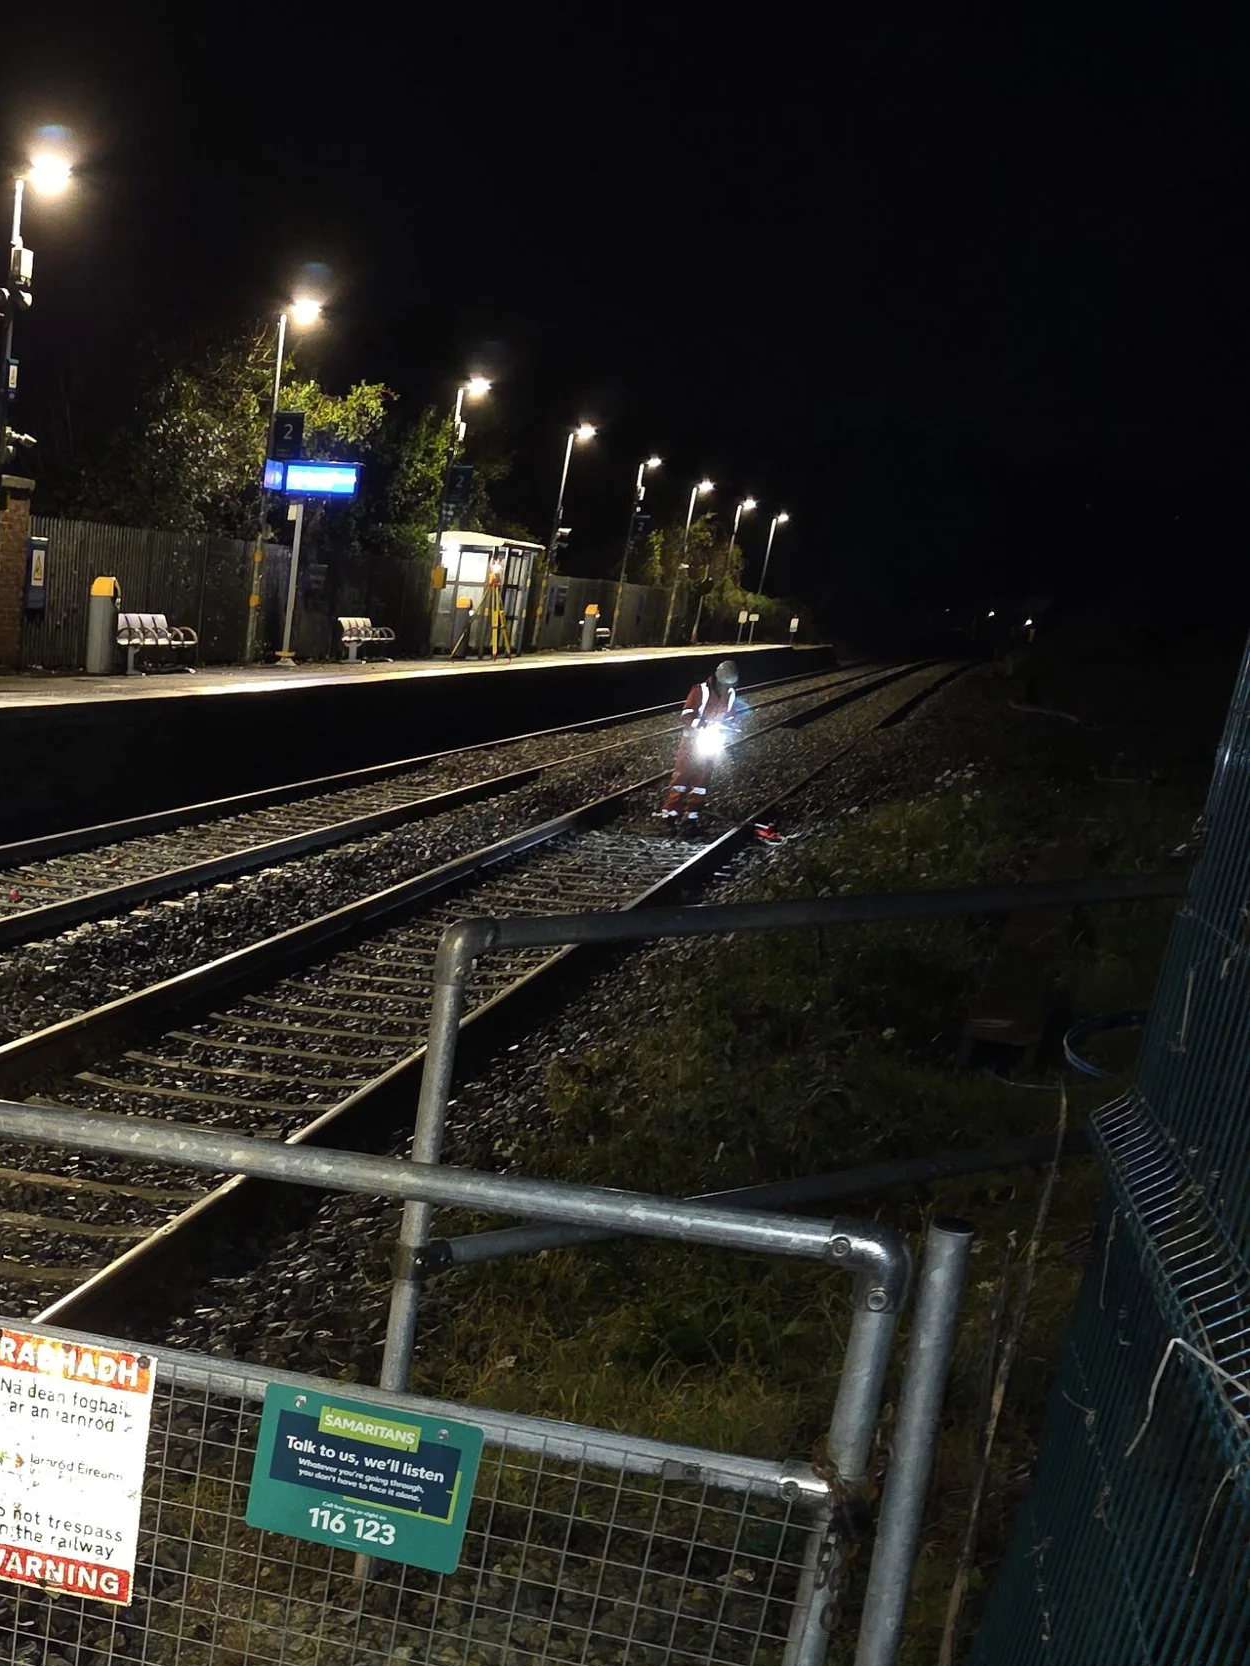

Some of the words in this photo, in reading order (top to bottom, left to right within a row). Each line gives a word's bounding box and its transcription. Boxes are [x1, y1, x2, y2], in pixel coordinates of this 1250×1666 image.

[283, 423, 294, 440] 2
[456, 475, 465, 489] 2
[9, 1400, 25, 1413] ar
[31, 1405, 49, 1419] an
[323, 1413, 417, 1445] SAMARITANS
[286, 1435, 316, 1455] Talk
[319, 1444, 335, 1459] to
[339, 1451, 360, 1466] us,
[402, 1462, 445, 1484] listen
[298, 1456, 338, 1474] Whatever
[365, 1474, 389, 1487] going
[390, 1479, 425, 1494] through,
[298, 1468, 315, 1479] you
[337, 1476, 358, 1488] have
[358, 1481, 368, 1490] to
[368, 1484, 387, 1495] face
[387, 1487, 395, 1496] it
[395, 1490, 421, 1502] alone.
[13, 1509, 41, 1526] not
[48, 1514, 123, 1543] trespass
[16, 1524, 43, 1543] the
[50, 1536, 115, 1561] railway
[308, 1507, 346, 1534] 116
[353, 1518, 397, 1546] 123
